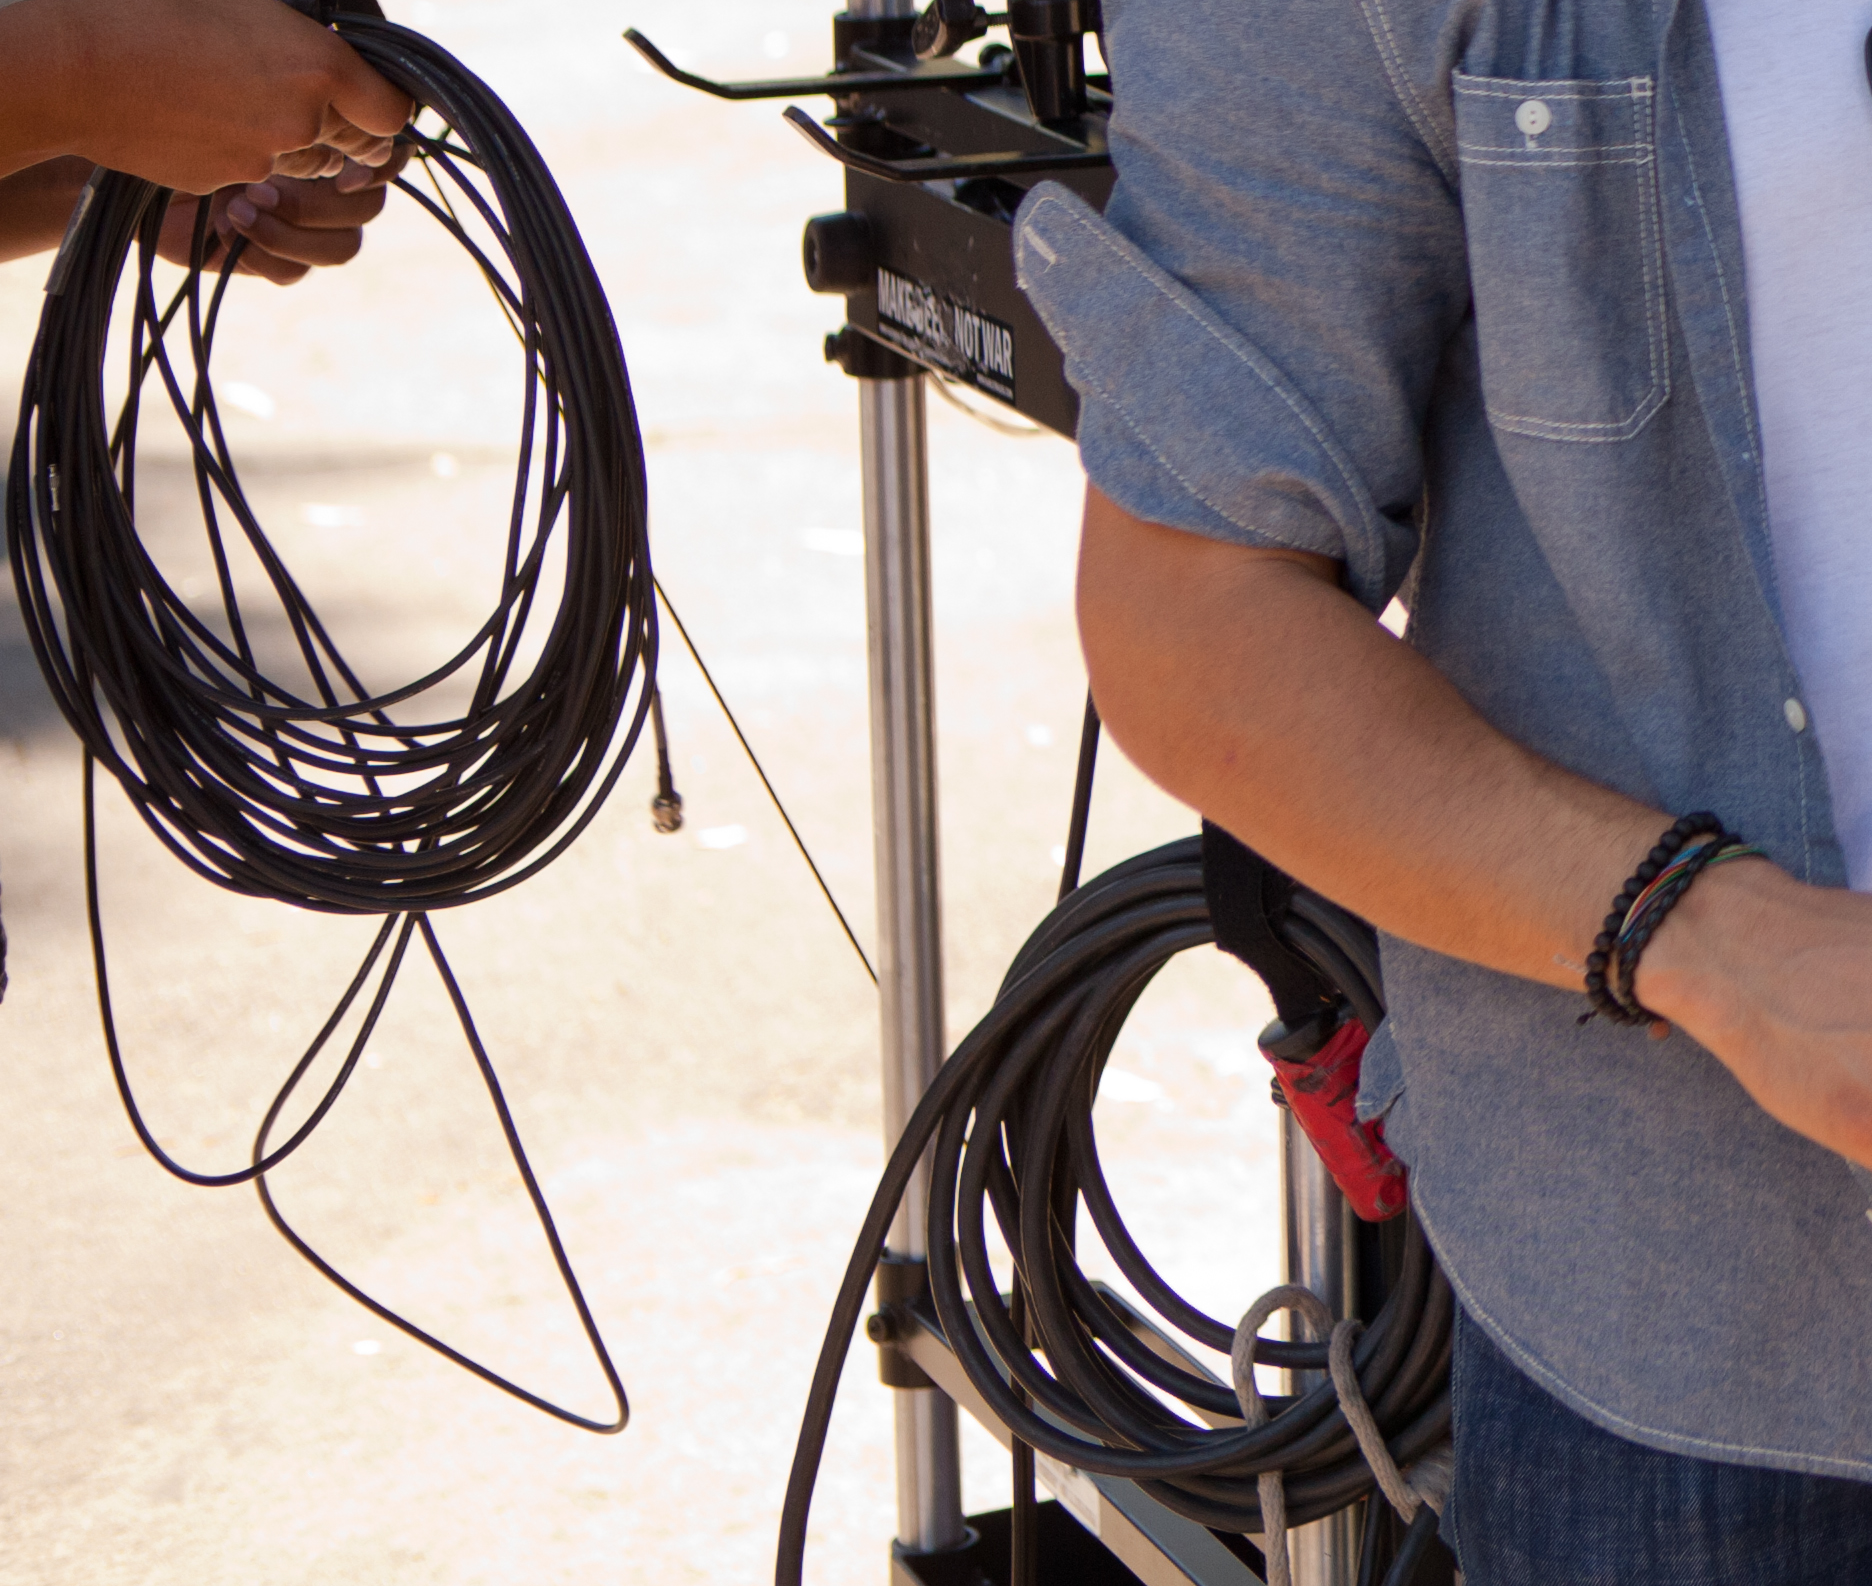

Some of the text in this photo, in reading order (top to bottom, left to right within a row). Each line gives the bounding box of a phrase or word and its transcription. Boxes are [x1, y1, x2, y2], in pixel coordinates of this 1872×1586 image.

[878, 266, 915, 329] MAKE
[954, 305, 981, 363] NOT
[981, 317, 1013, 380] WAR
